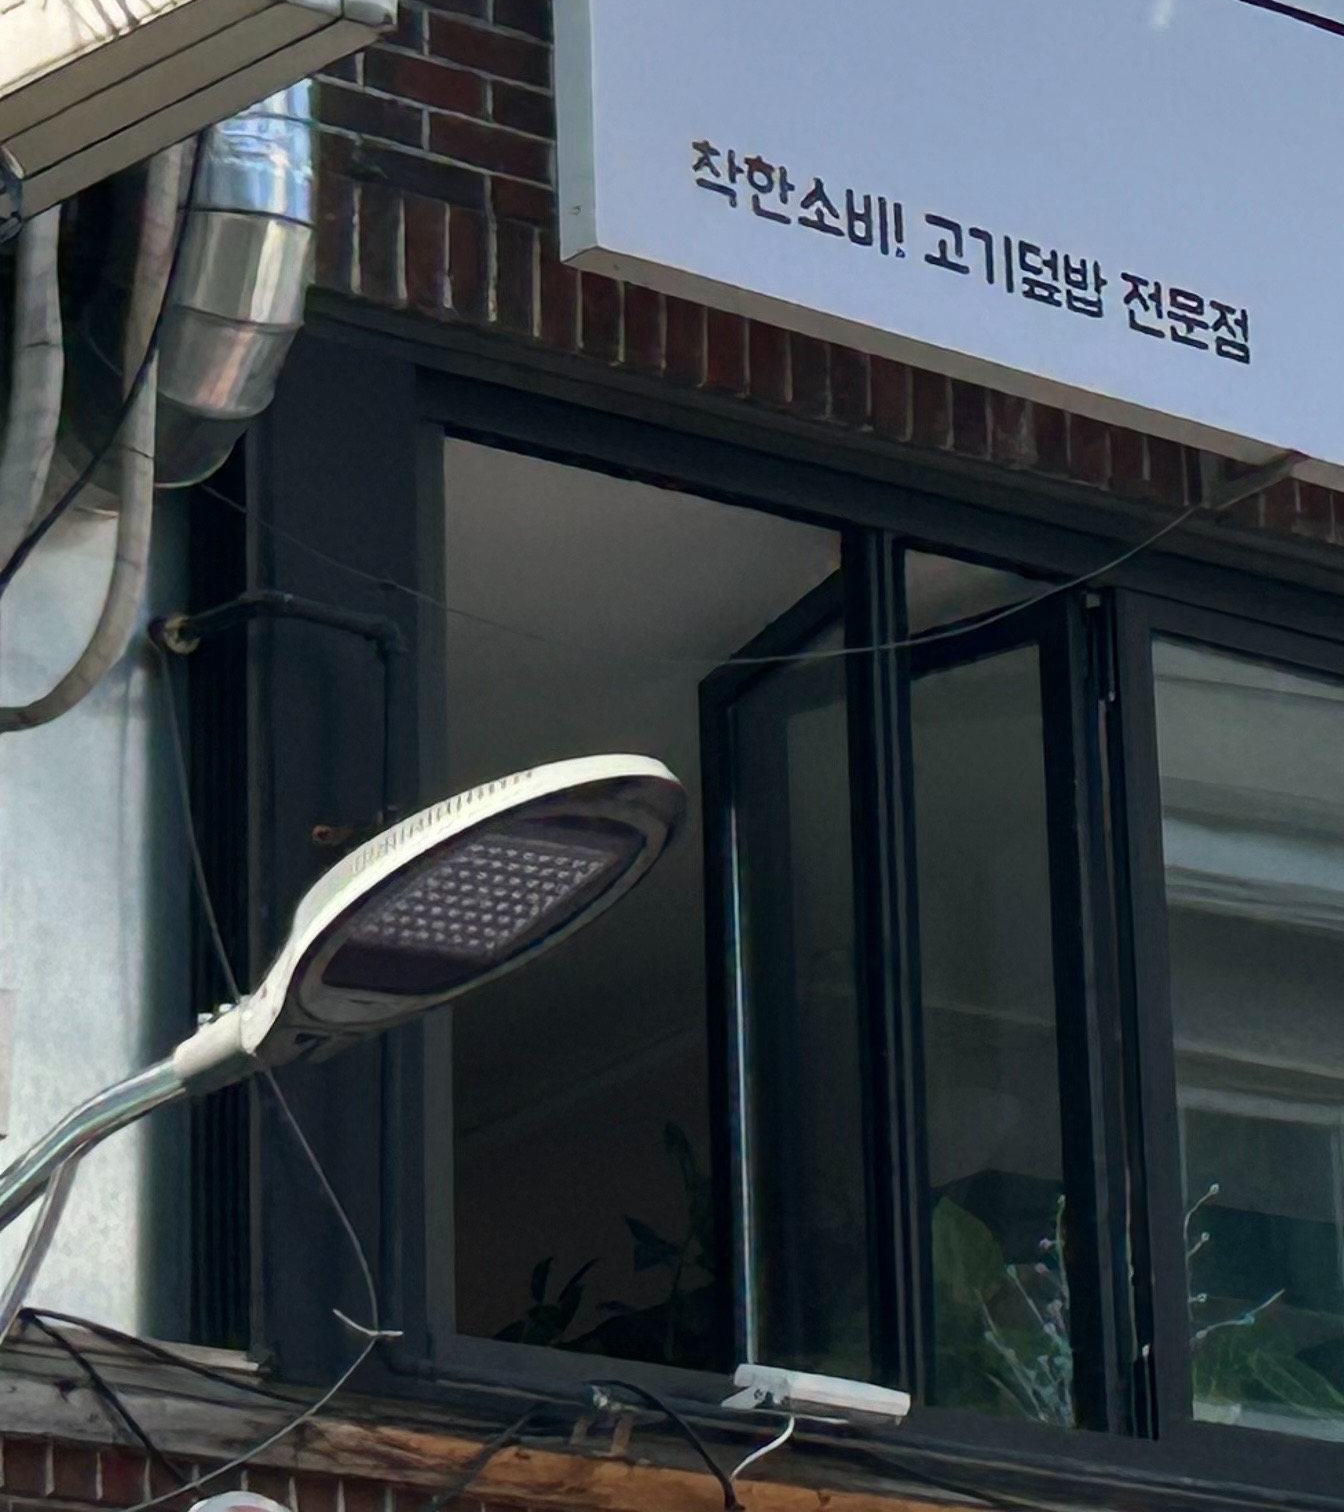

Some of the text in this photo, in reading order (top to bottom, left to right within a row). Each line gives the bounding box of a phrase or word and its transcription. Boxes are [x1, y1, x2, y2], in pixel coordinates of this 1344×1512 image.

[692, 140, 1251, 365] 착한소비! 고기덮밥 전문점
